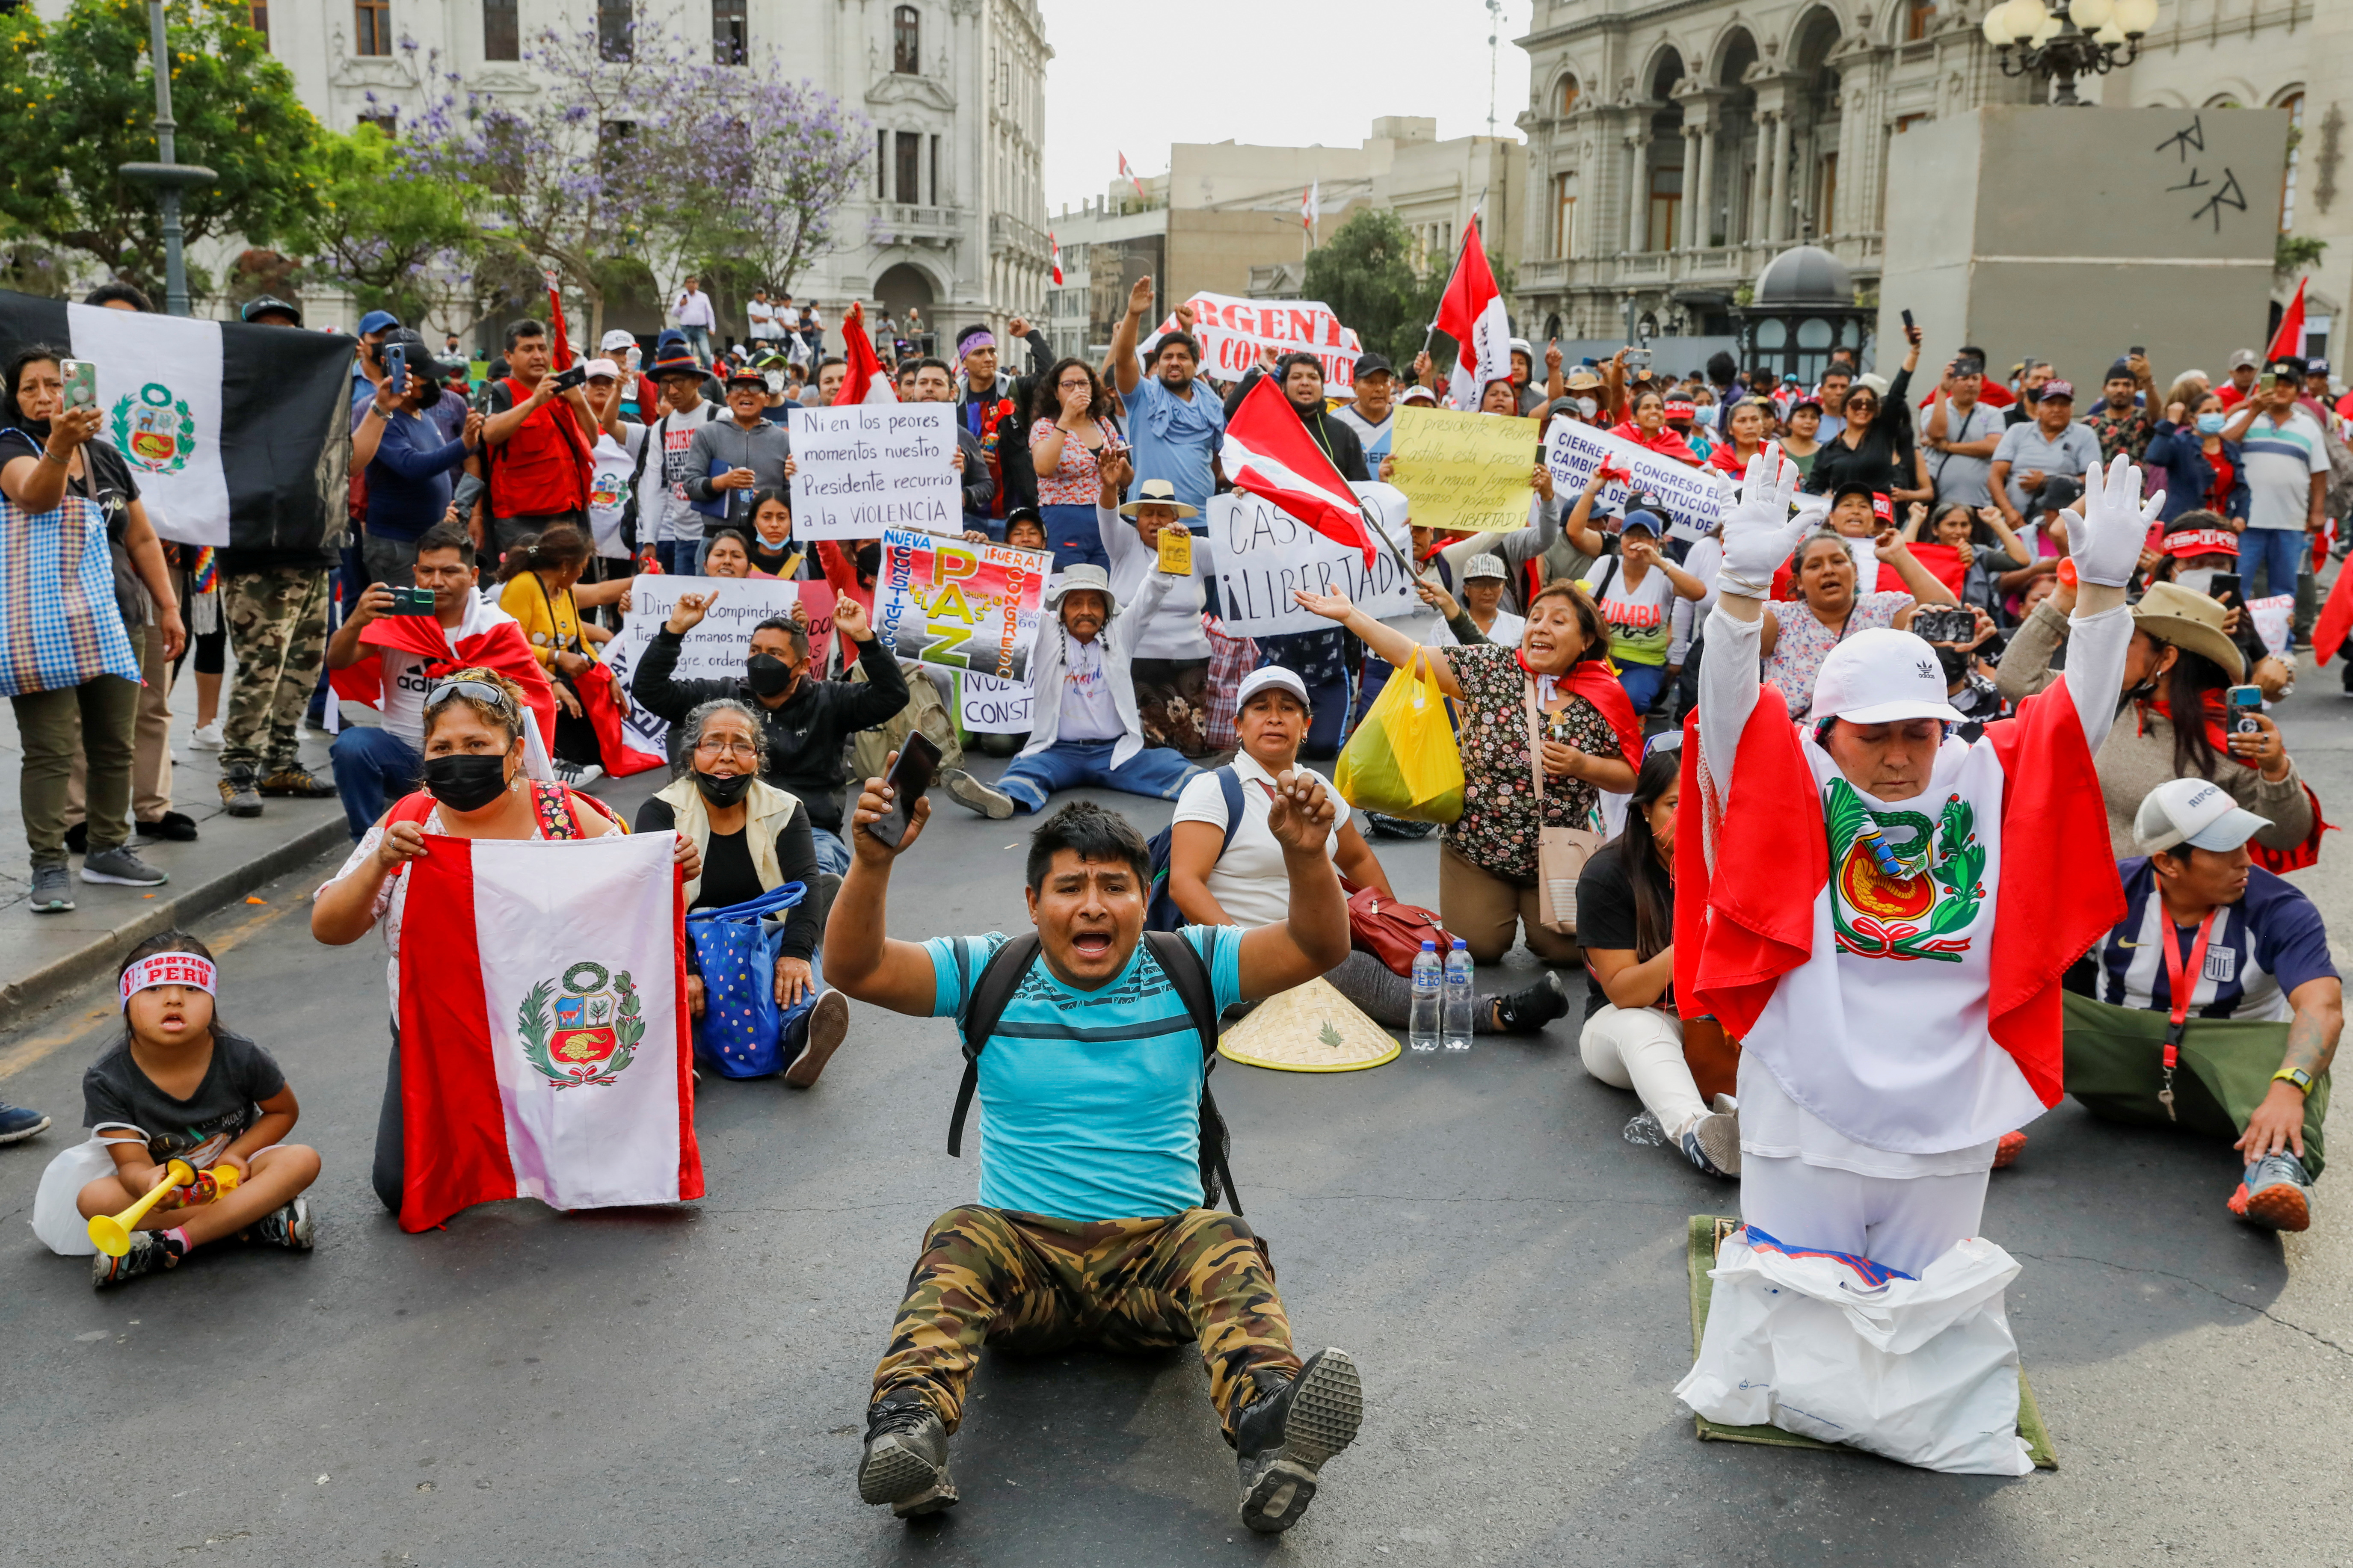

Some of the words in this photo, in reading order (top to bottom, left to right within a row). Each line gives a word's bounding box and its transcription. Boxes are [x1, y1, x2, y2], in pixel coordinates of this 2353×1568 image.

[805, 412, 824, 433] Ni
[832, 420, 850, 432] en
[859, 409, 880, 429] los
[889, 414, 939, 434] peores
[1396, 411, 1415, 430] El
[1418, 416, 1489, 441] presidente
[1498, 418, 1536, 441] Pedro
[805, 440, 877, 461] momentos
[885, 436, 939, 458] nuestro
[1394, 437, 1444, 464] Castillo
[1483, 451, 1526, 471] preso
[1559, 432, 1605, 458] CIERRE
[1634, 462, 1703, 494] CONGRESO
[802, 470, 885, 496] Presidente
[894, 470, 952, 489] recurrió
[804, 514, 813, 527] a
[822, 508, 836, 525] la
[883, 529, 931, 550] NUEVA
[641, 592, 676, 615] Din
[1018, 610, 1040, 619] SOLO
[695, 633, 733, 643] manos
[144, 956, 211, 973] CONTIGO
[148, 966, 209, 987] PERÚ
